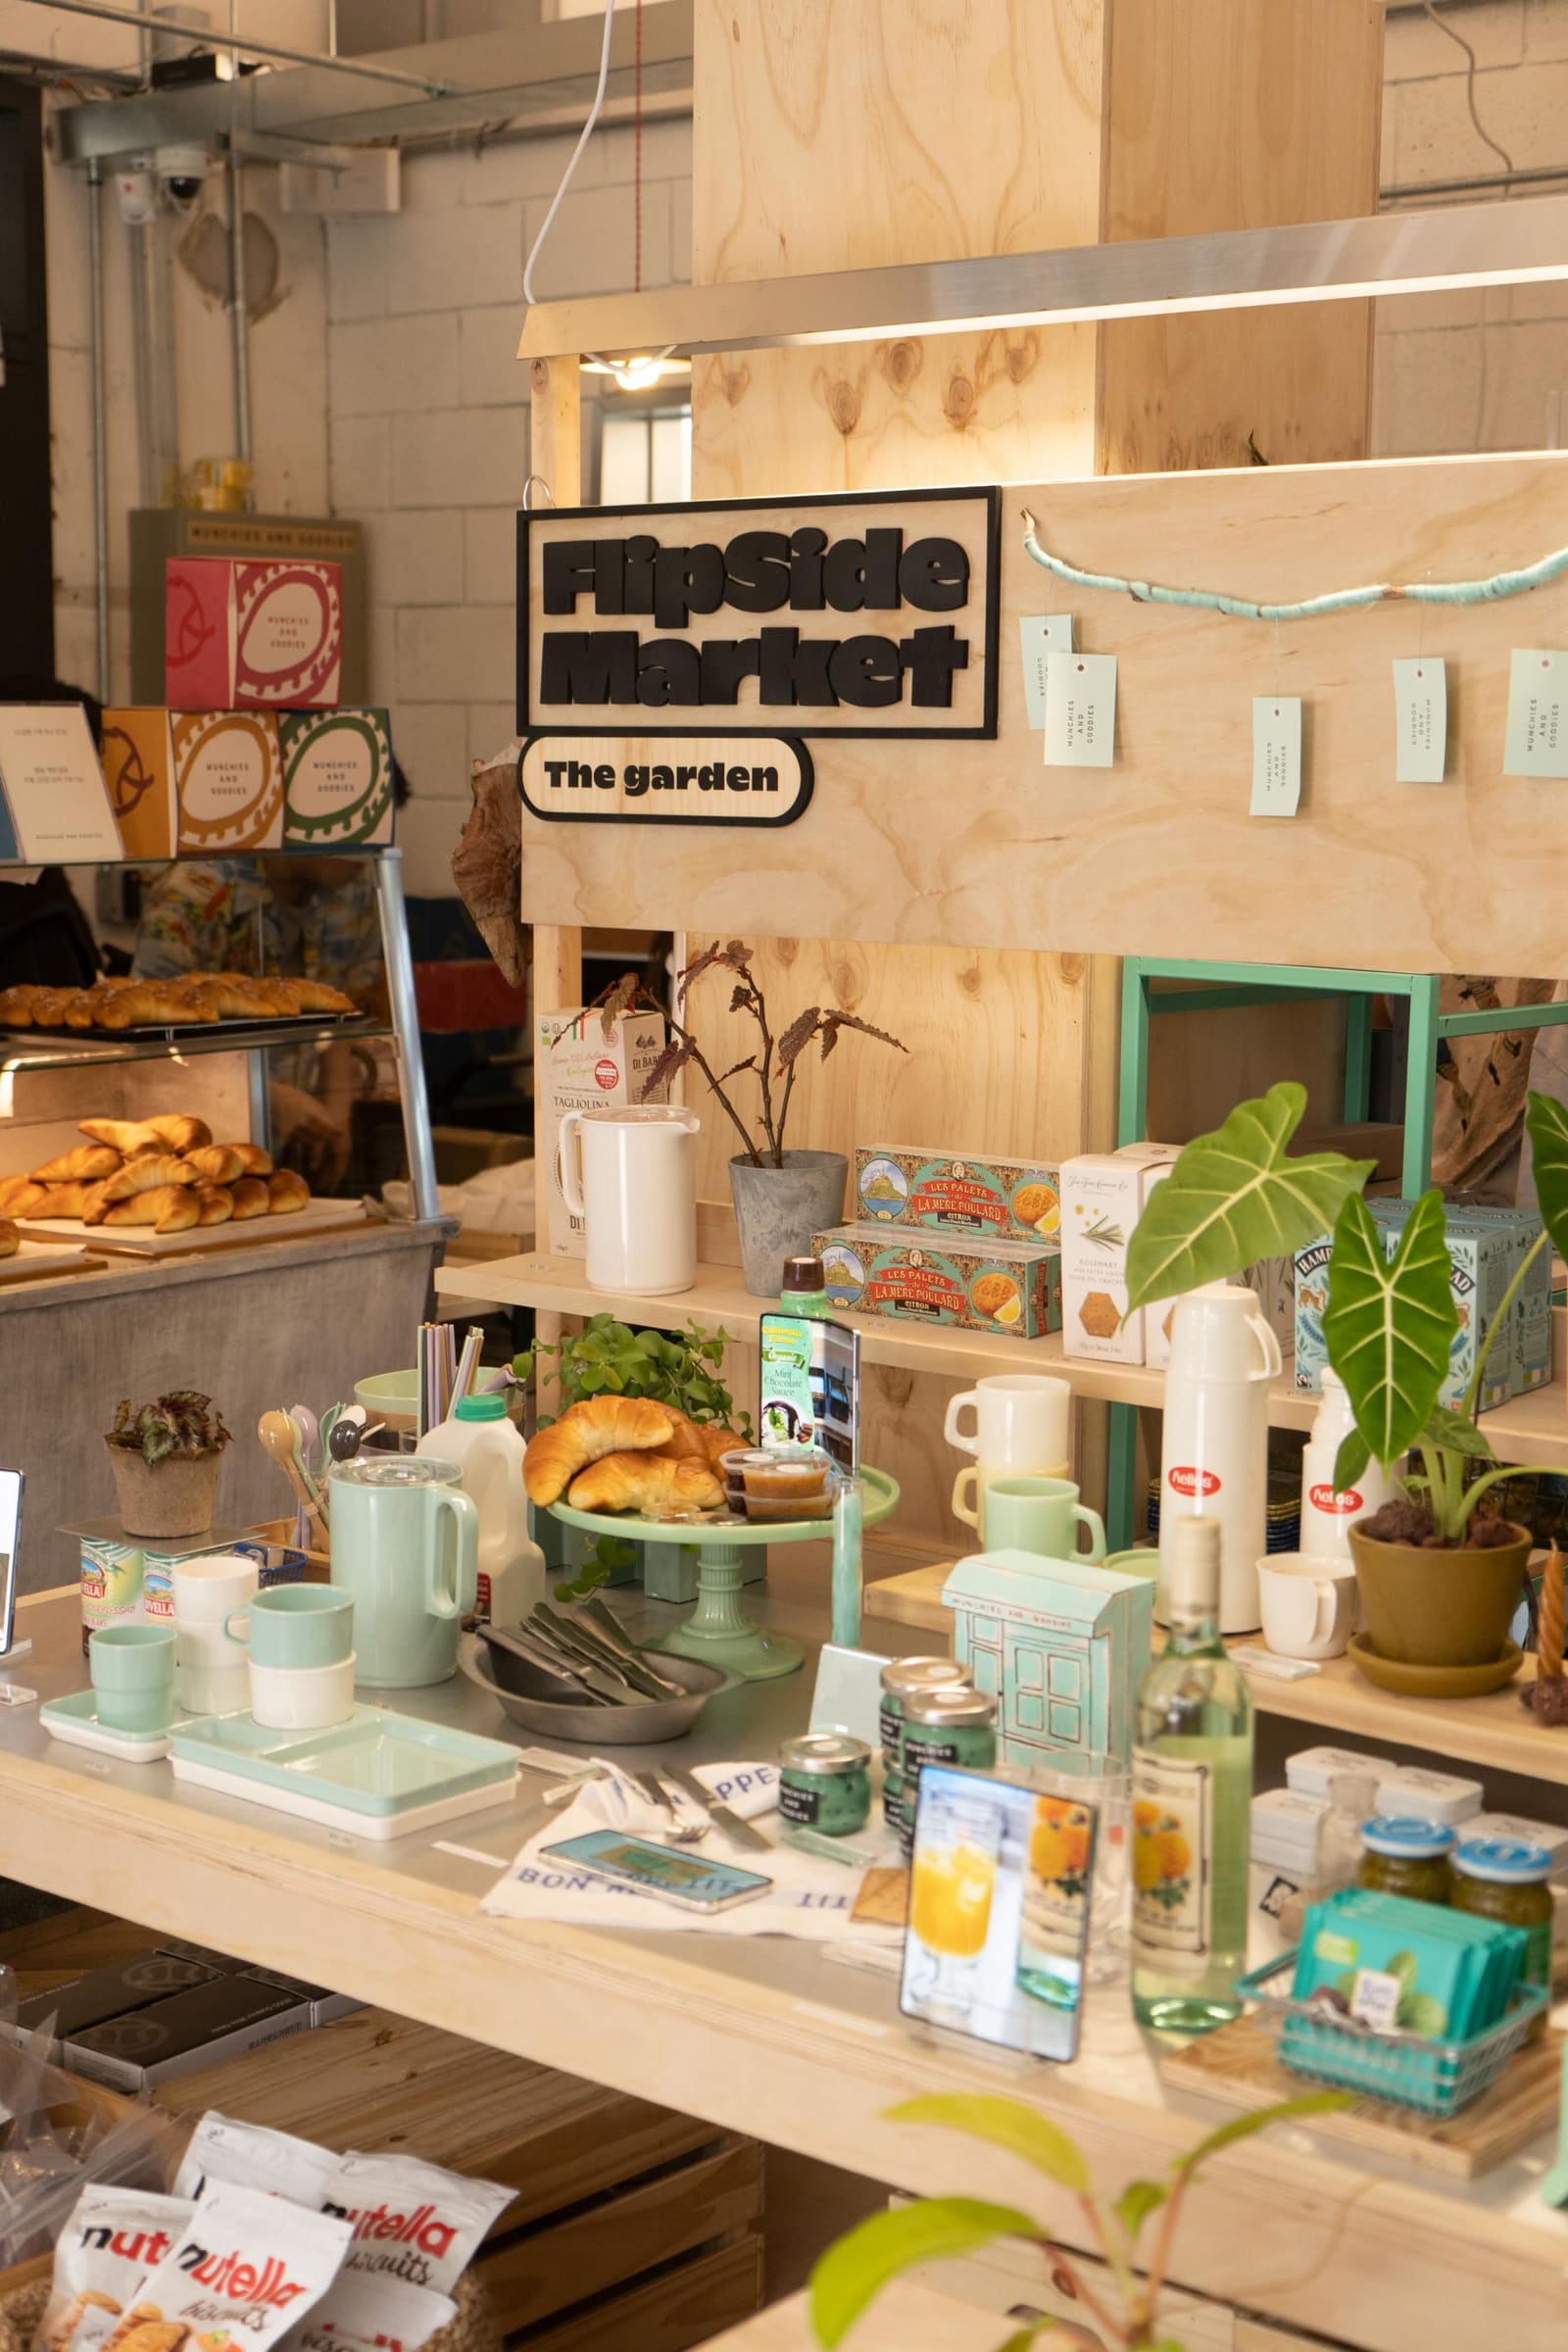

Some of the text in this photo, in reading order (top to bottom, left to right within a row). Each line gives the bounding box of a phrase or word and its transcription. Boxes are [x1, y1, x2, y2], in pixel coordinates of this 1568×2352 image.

[543, 527, 970, 629] FlipSide
[540, 624, 969, 708] Market
[1527, 699, 1538, 752] MUNCHIES
[1549, 704, 1559, 749] GOODIES
[206, 762, 249, 771] MUNCHIES
[313, 760, 357, 769] MUNCHIES
[318, 784, 355, 793] GOODIES
[544, 760, 779, 797] The garden
[642, 1056, 661, 1068] BAR
[931, 1183, 988, 1199] LES PALETS
[918, 1199, 930, 1211] LA
[958, 1200, 1001, 1222] POULARD
[888, 1270, 946, 1287] LES PALETS
[875, 1286, 888, 1299] LA
[916, 1289, 959, 1310] POULARD
[764, 1376, 804, 1389] Chocolate
[771, 1386, 796, 1396] Sauce
[1313, 1489, 1354, 1506] helos
[517, 1868, 589, 1890] BON
[79, 2228, 172, 2266] nut
[176, 2243, 307, 2310] nutella
